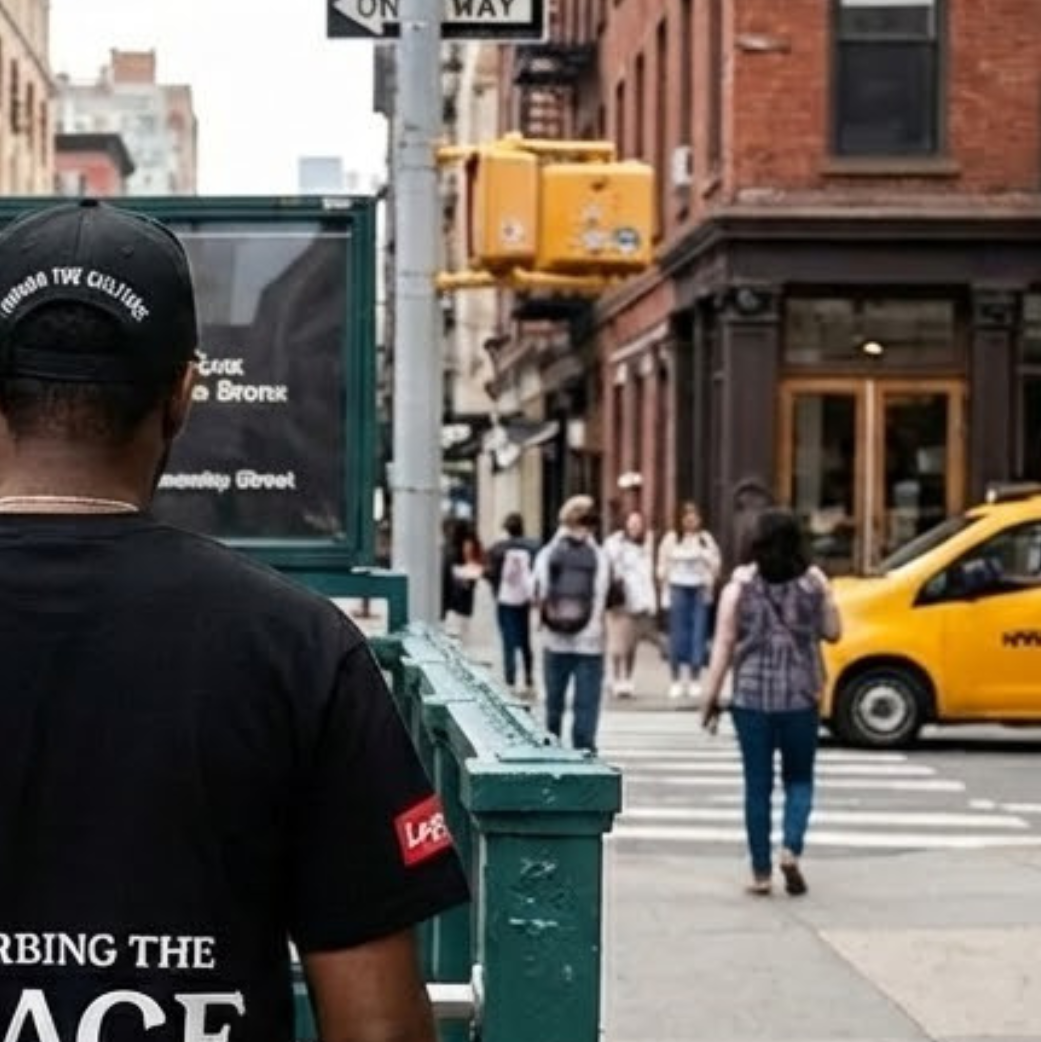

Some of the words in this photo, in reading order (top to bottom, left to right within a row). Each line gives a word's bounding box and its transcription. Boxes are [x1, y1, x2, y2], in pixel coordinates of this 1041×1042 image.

[358, 0, 398, 17] ON
[452, 0, 514, 17] WAY
[128, 935, 215, 969] THE
